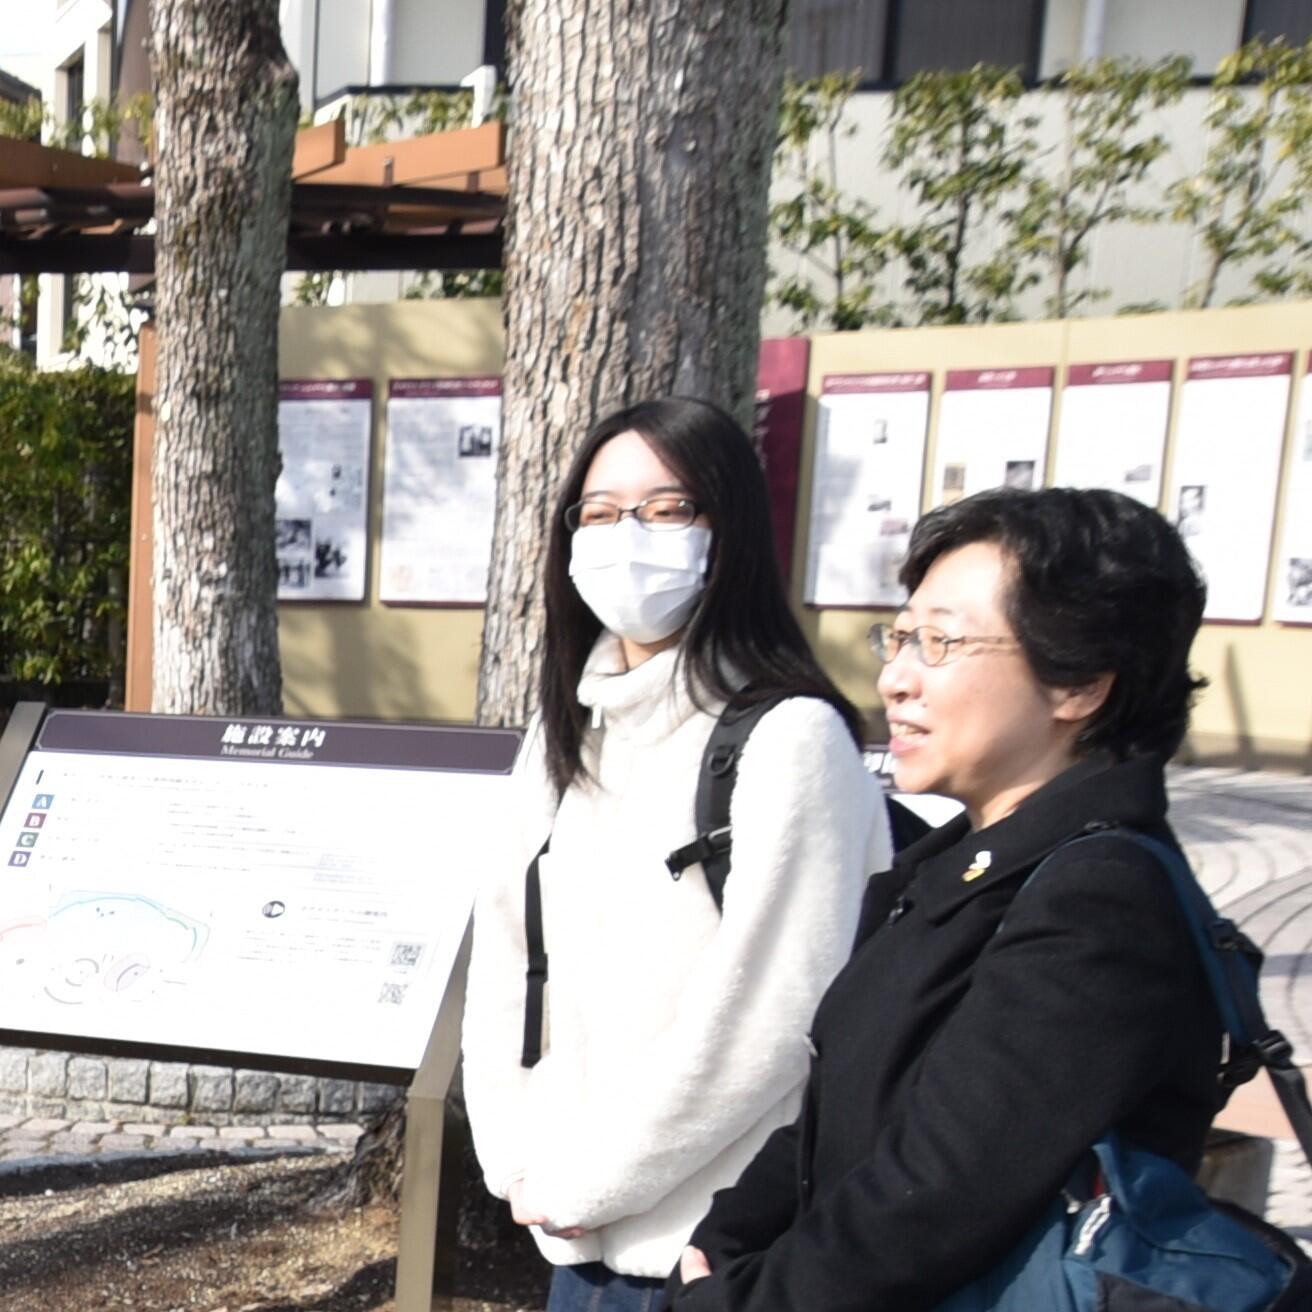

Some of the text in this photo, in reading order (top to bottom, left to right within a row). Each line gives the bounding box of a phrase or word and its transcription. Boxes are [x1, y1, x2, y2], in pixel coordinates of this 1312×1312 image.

[221, 723, 326, 748] 施設案内
[220, 744, 314, 759] Memorial Guide
[35, 795, 48, 809] A
[28, 814, 41, 827] B
[13, 852, 28, 865] D
